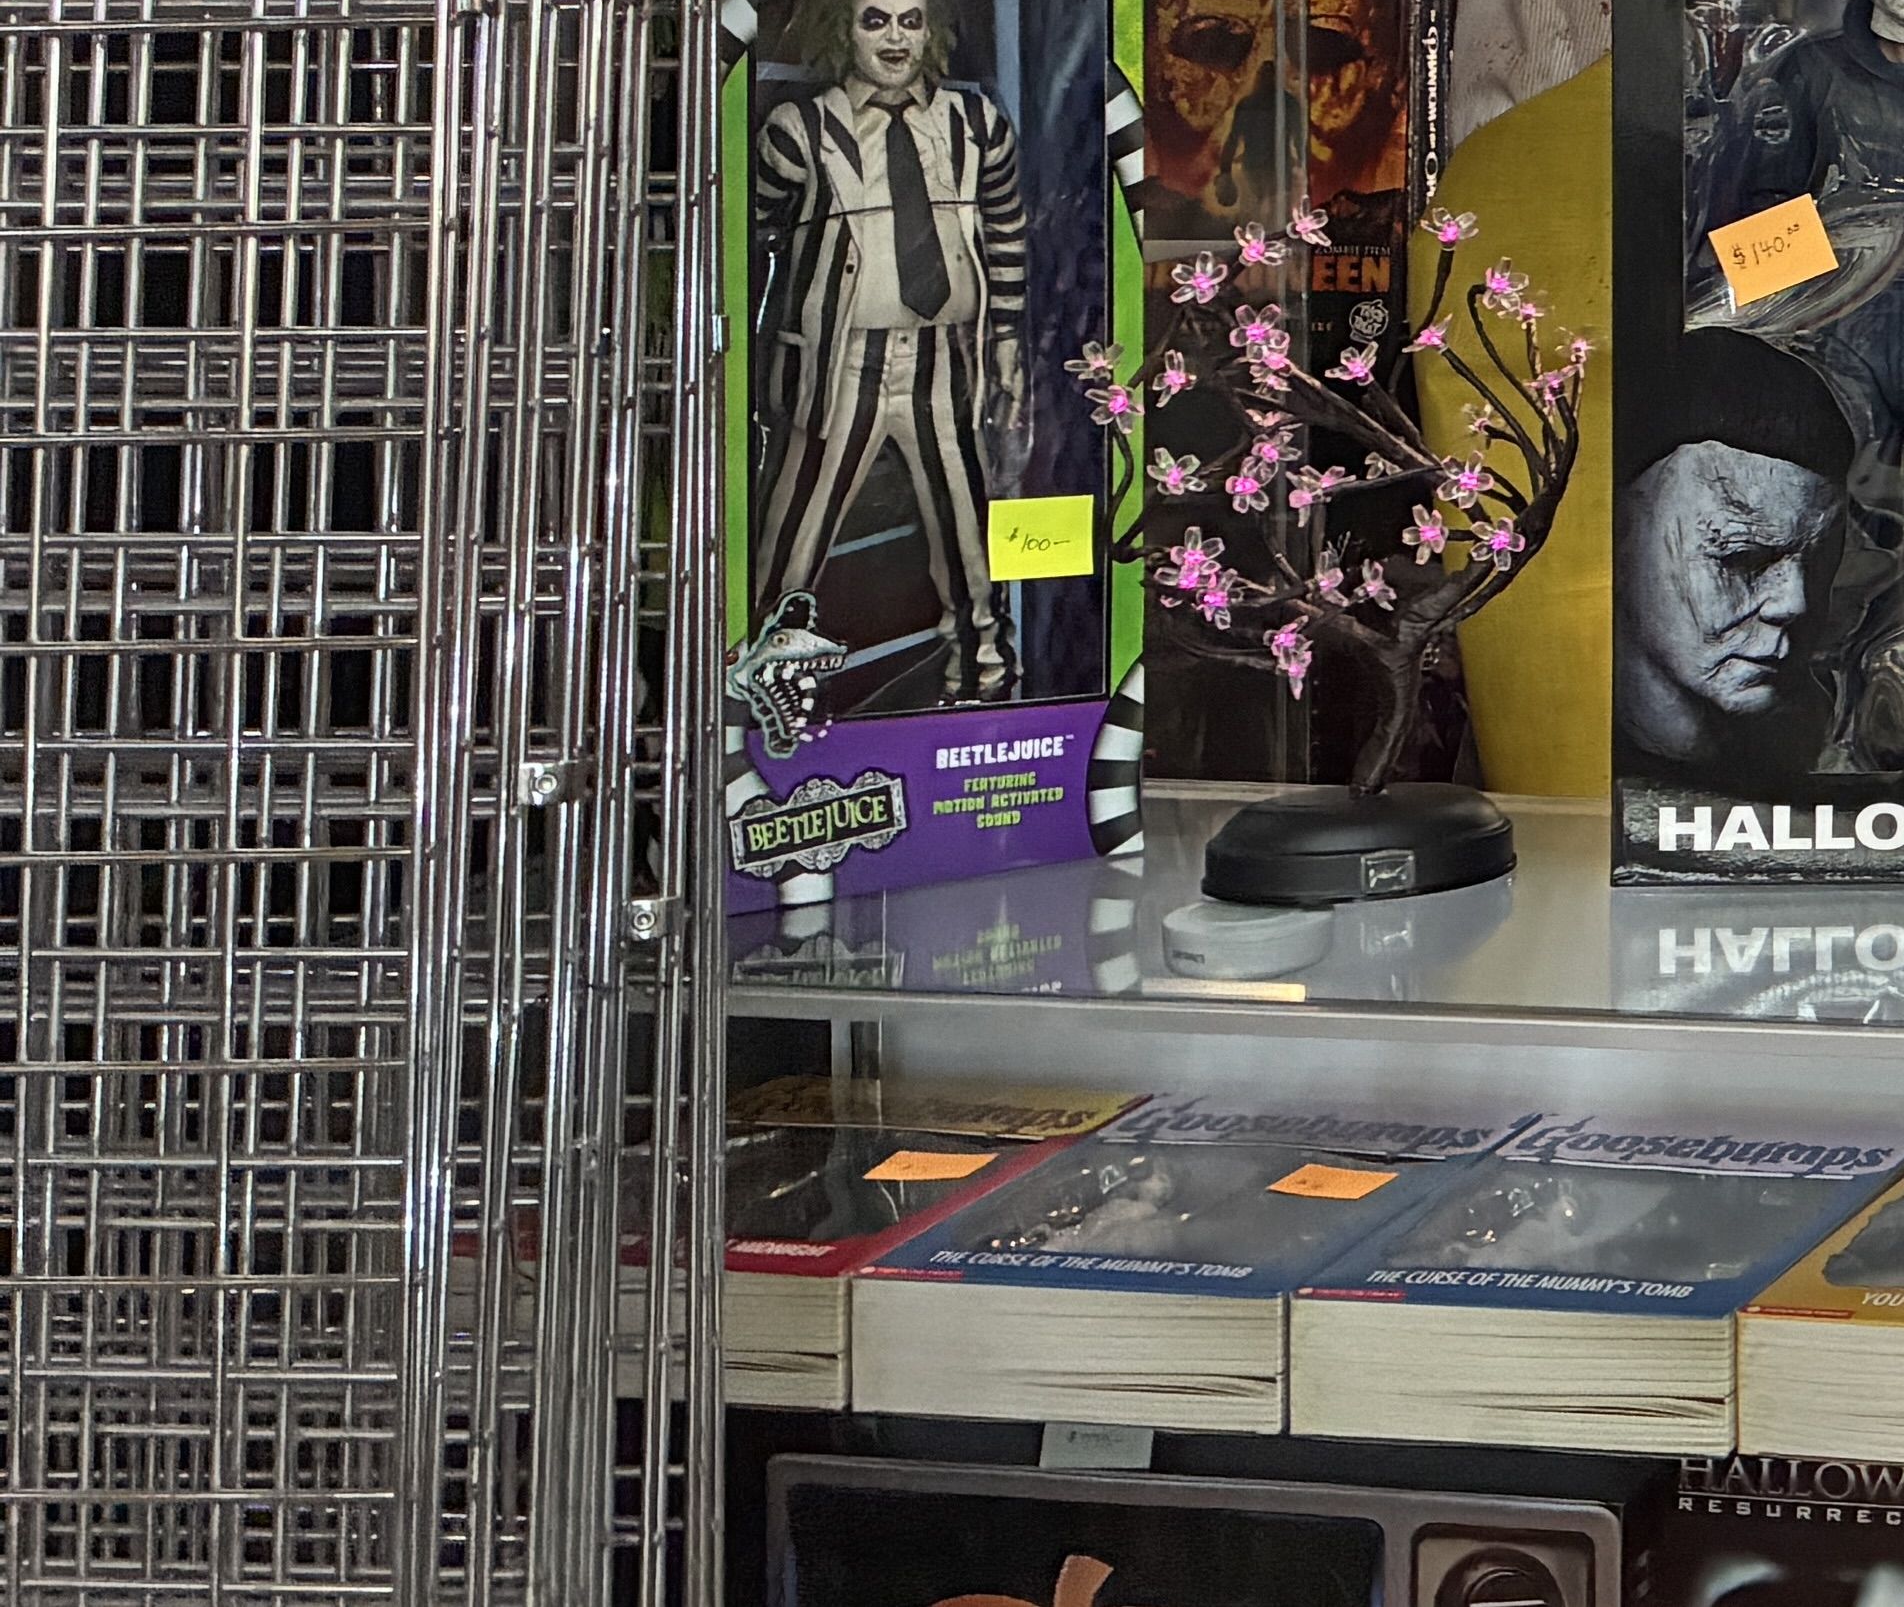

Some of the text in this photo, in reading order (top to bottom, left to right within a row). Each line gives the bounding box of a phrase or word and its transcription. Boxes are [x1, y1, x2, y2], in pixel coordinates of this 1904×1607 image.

[964, 771, 1037, 793] FEATURING
[747, 793, 888, 853] BEETLEJUICE
[1516, 1113, 1895, 1182] Goosebumps
[929, 1249, 967, 1265] THE
[969, 1250, 1027, 1269] CURSE
[1030, 1254, 1057, 1270] OF
[1058, 1255, 1096, 1272] THE
[1192, 1262, 1253, 1280] TOMB
[1366, 1269, 1696, 1299] THE CURSE OF THE MUMMY'S TOMB
